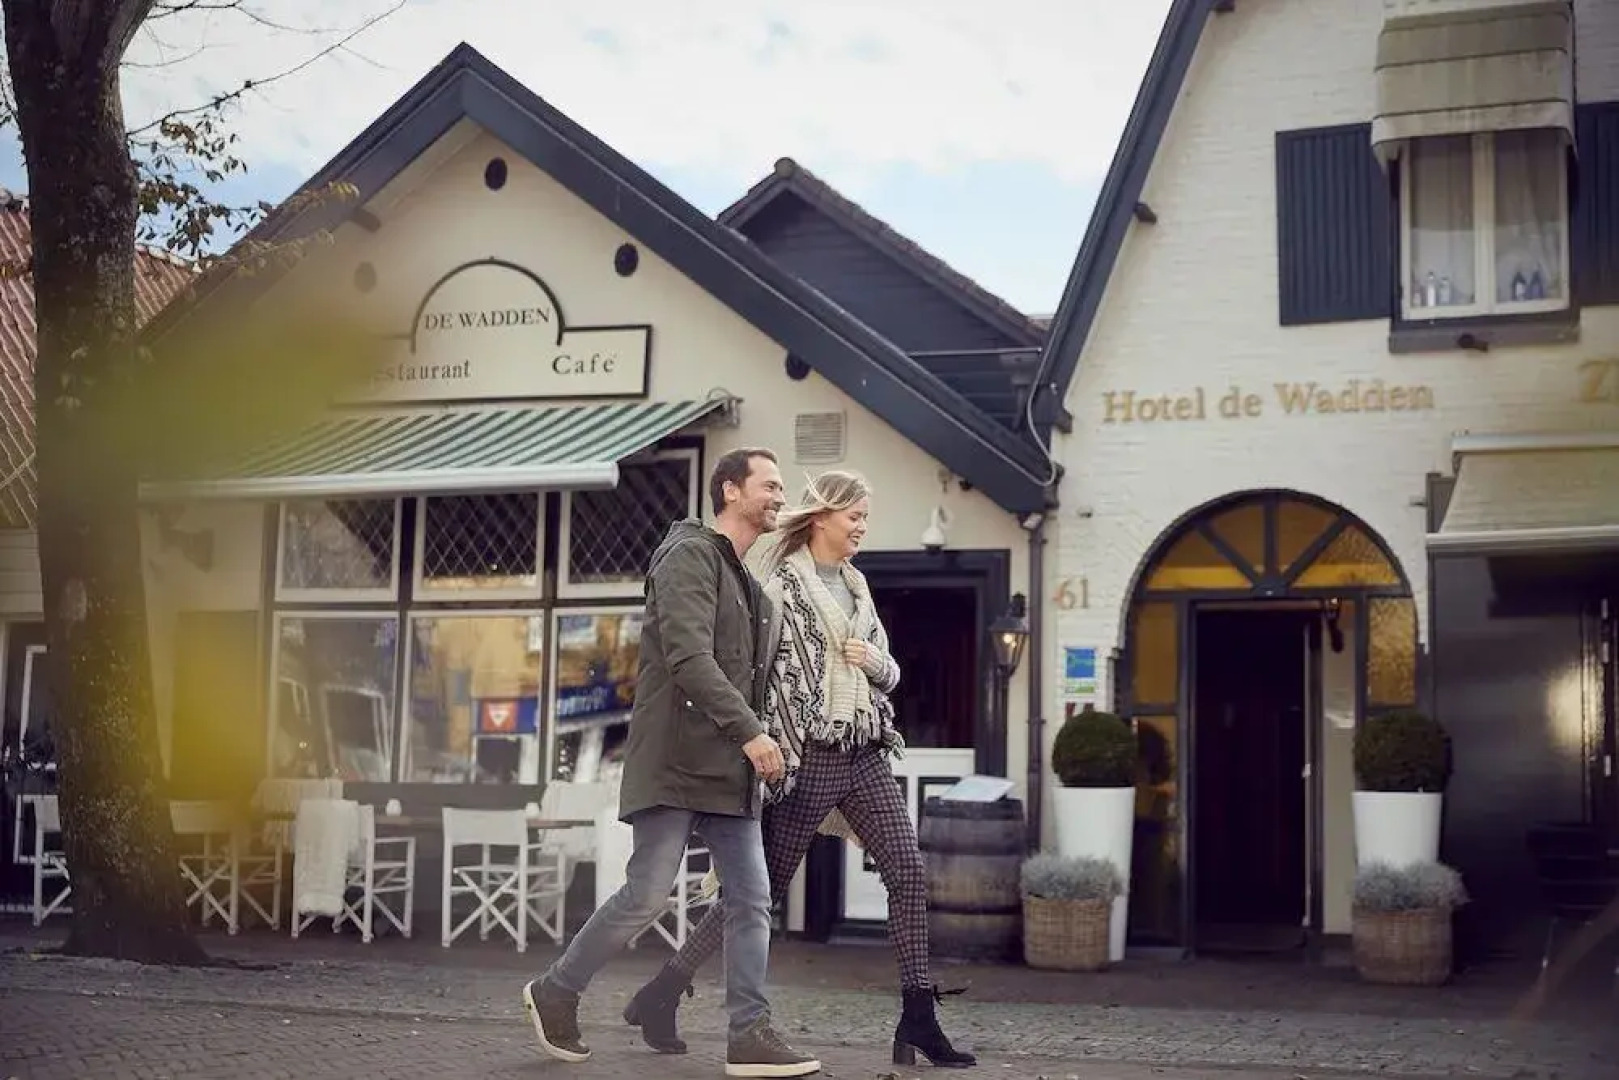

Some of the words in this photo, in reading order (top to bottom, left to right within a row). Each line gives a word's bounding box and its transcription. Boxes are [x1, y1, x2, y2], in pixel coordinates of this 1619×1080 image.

[424, 313, 453, 330] DE
[459, 307, 550, 328] WADDEN
[552, 352, 617, 375] Café
[1102, 386, 1207, 424] Hotel
[1218, 386, 1263, 419] de
[1273, 378, 1435, 415] Wadden
[1056, 578, 1089, 611] 61
